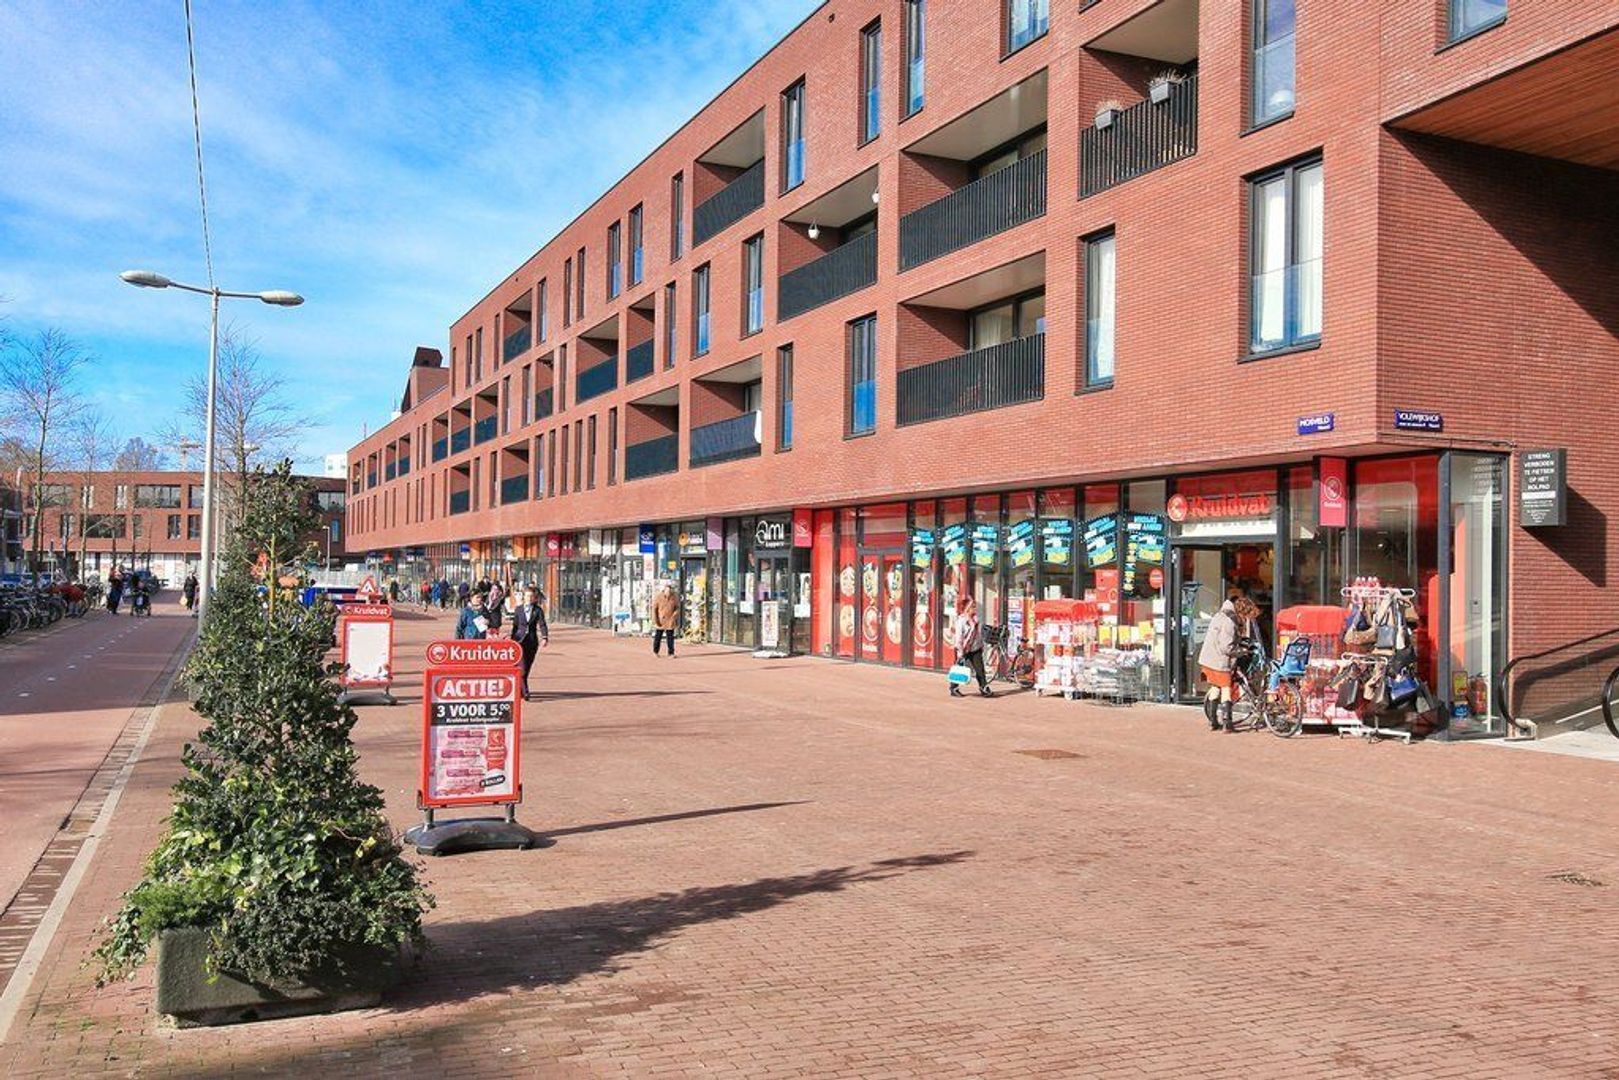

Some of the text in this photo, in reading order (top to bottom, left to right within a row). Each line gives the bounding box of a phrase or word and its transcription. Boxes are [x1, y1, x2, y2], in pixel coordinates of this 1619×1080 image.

[1189, 493, 1270, 517] Kruidvat
[354, 606, 388, 615] Kruidvat
[450, 645, 515, 661] Kruidvat
[441, 678, 505, 697] ACTIE!
[436, 705, 446, 717] 3
[449, 704, 486, 717] VOOR
